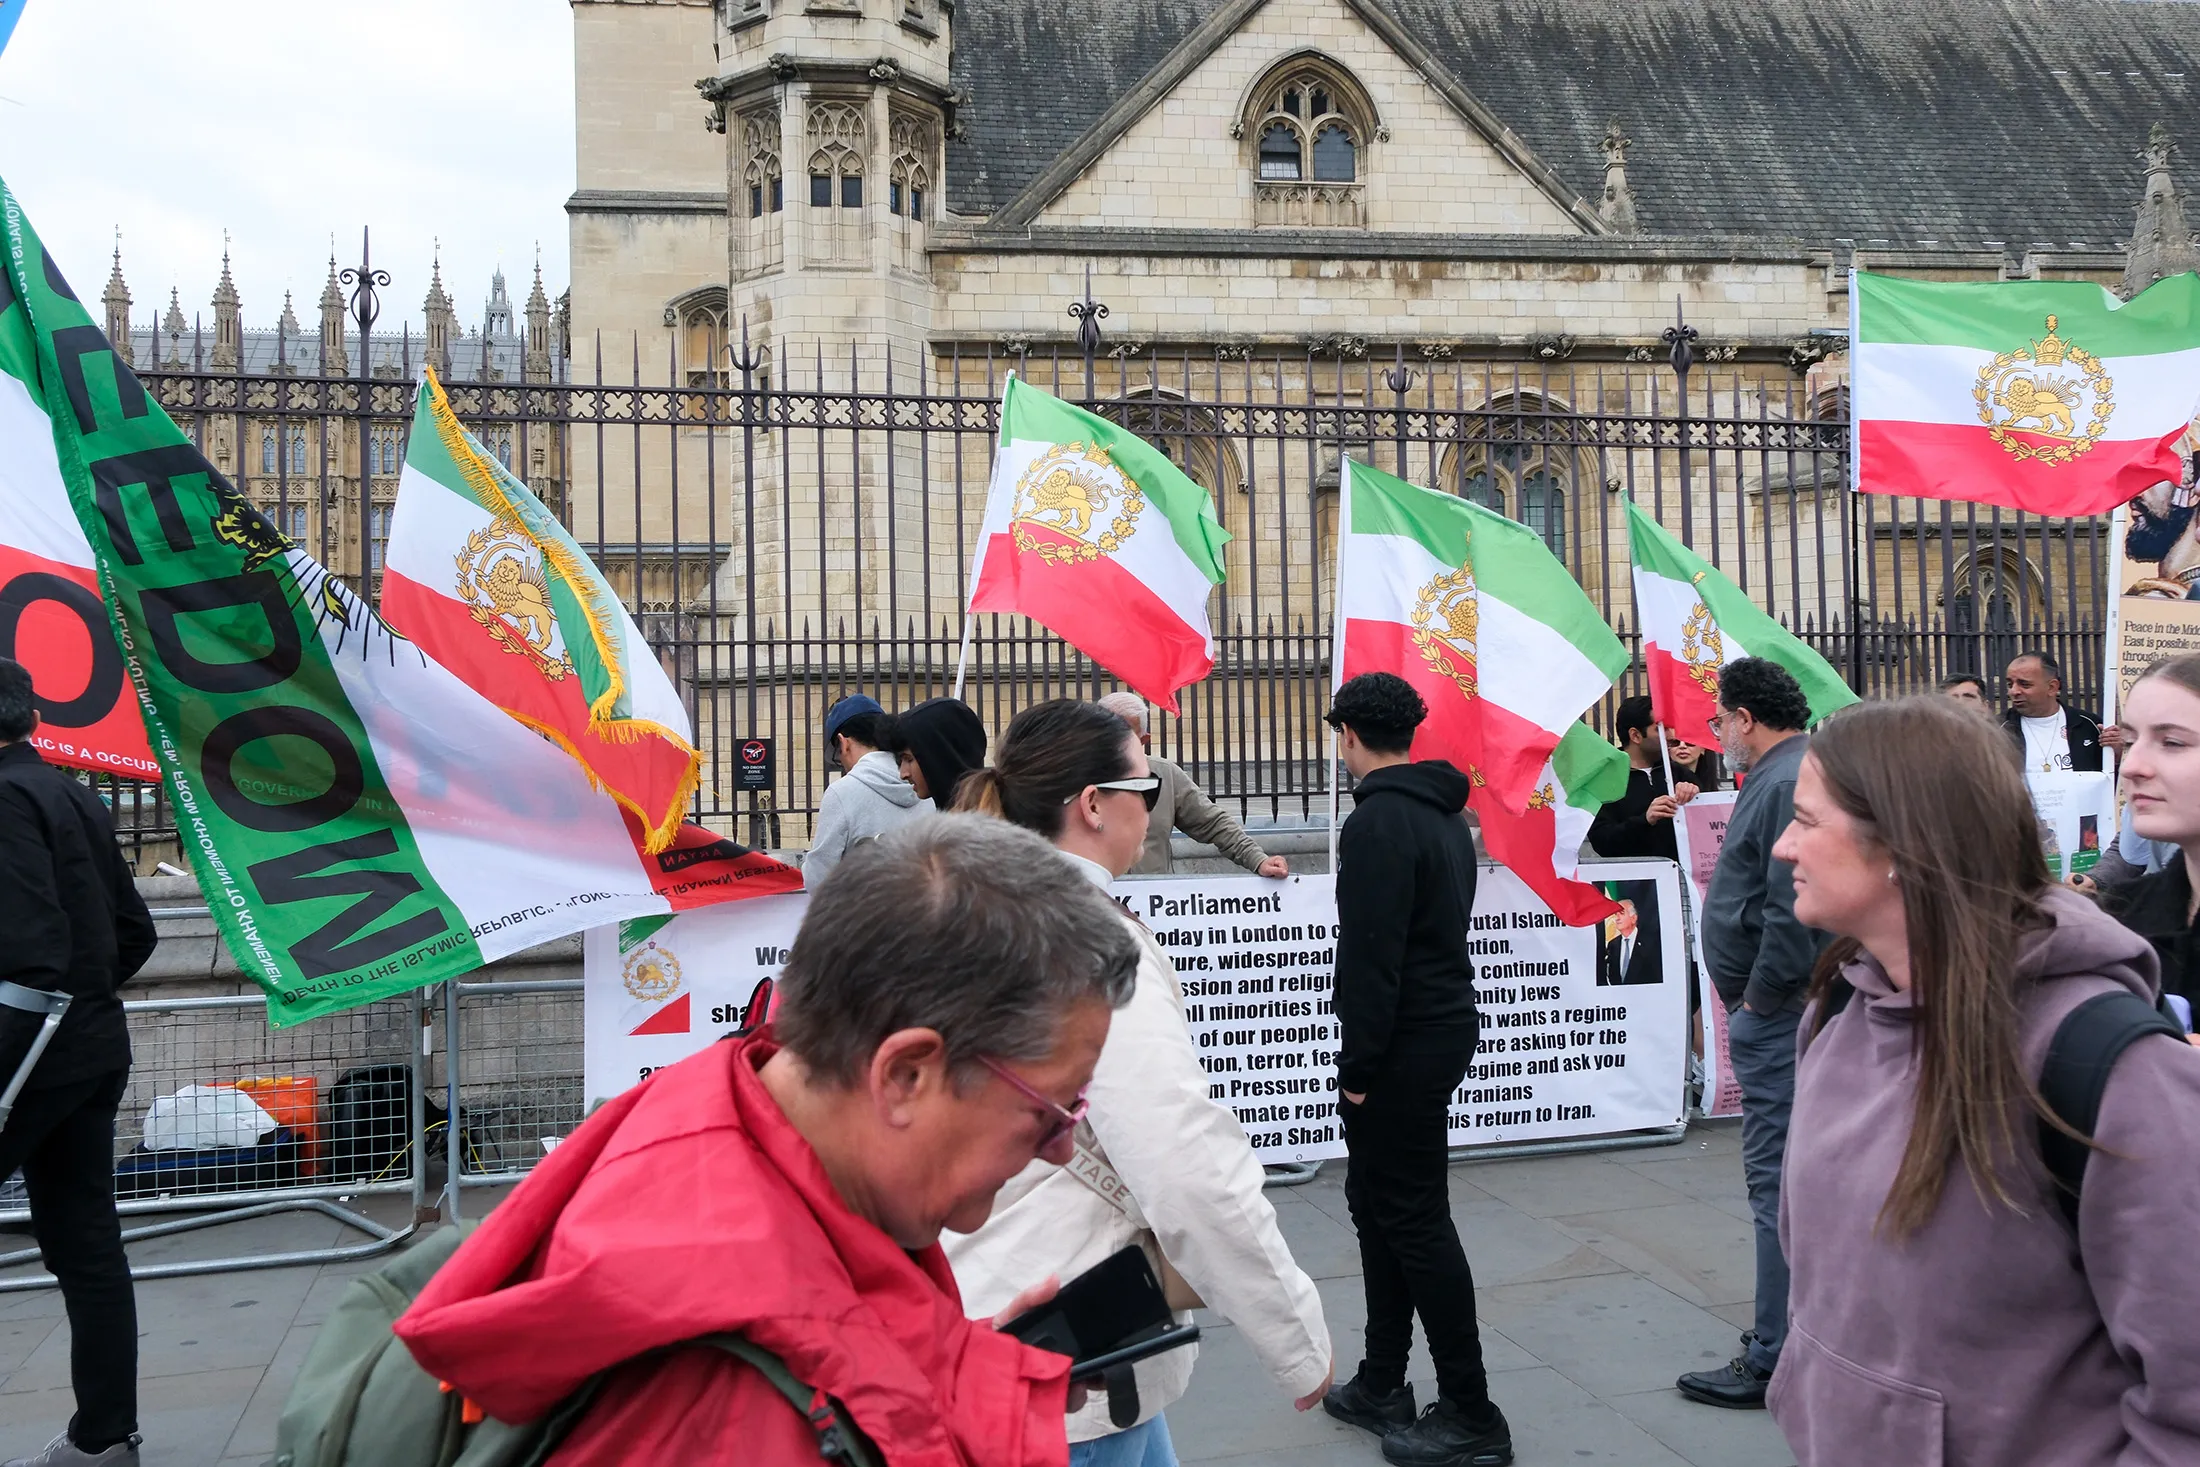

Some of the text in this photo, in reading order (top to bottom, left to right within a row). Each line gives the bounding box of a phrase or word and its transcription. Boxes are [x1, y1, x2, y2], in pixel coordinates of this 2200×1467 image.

[2124, 620, 2153, 633] Peace
[2154, 623, 2164, 633] in
[2166, 624, 2180, 634] the
[2124, 635, 2144, 647] East
[2147, 637, 2155, 647] is
[2155, 639, 2190, 650] possible
[59, 744, 75, 755] IS
[80, 748, 92, 760] A
[96, 751, 161, 773] OCCUP
[1150, 891, 1281, 917] Parliament
[1155, 928, 1202, 948] oday
[1208, 927, 1226, 945] in
[1232, 924, 1304, 944] London
[1308, 923, 1326, 940] to
[1512, 911, 1566, 929] Islam
[1218, 947, 1333, 970] widespread
[1182, 979, 1232, 997] ssion
[1238, 975, 1273, 994] and
[1279, 973, 1337, 993] religi
[1481, 959, 1569, 980] continued
[1209, 1000, 1312, 1021] minorities
[1474, 986, 1516, 1004] anity
[1521, 985, 1561, 1001] Jews
[1200, 1029, 1218, 1048] of
[1223, 1029, 1256, 1046] our
[1261, 1024, 1328, 1046] people
[1496, 1009, 1547, 1028] wants
[1551, 1009, 1560, 1024] a
[1564, 1005, 1627, 1024] regime
[1246, 1052, 1308, 1070] terror,
[1510, 1032, 1566, 1051] asking
[1570, 1029, 1594, 1047] for
[1599, 1028, 1627, 1045] the
[1230, 1077, 1321, 1098] Pressure
[1466, 1060, 1522, 1080] egime
[1527, 1056, 1559, 1075] and
[1563, 1053, 1591, 1072] ask
[1594, 1053, 1626, 1071] you
[1232, 1104, 1290, 1123] imate
[1457, 1085, 1533, 1105] Iranians
[1247, 1131, 1283, 1149] eza
[1287, 1125, 1334, 1145] Shah
[1475, 1107, 1531, 1128] return
[1536, 1106, 1552, 1122] to
[1557, 1104, 1596, 1121] Iran.
[1075, 1153, 1130, 1202] TAGE
